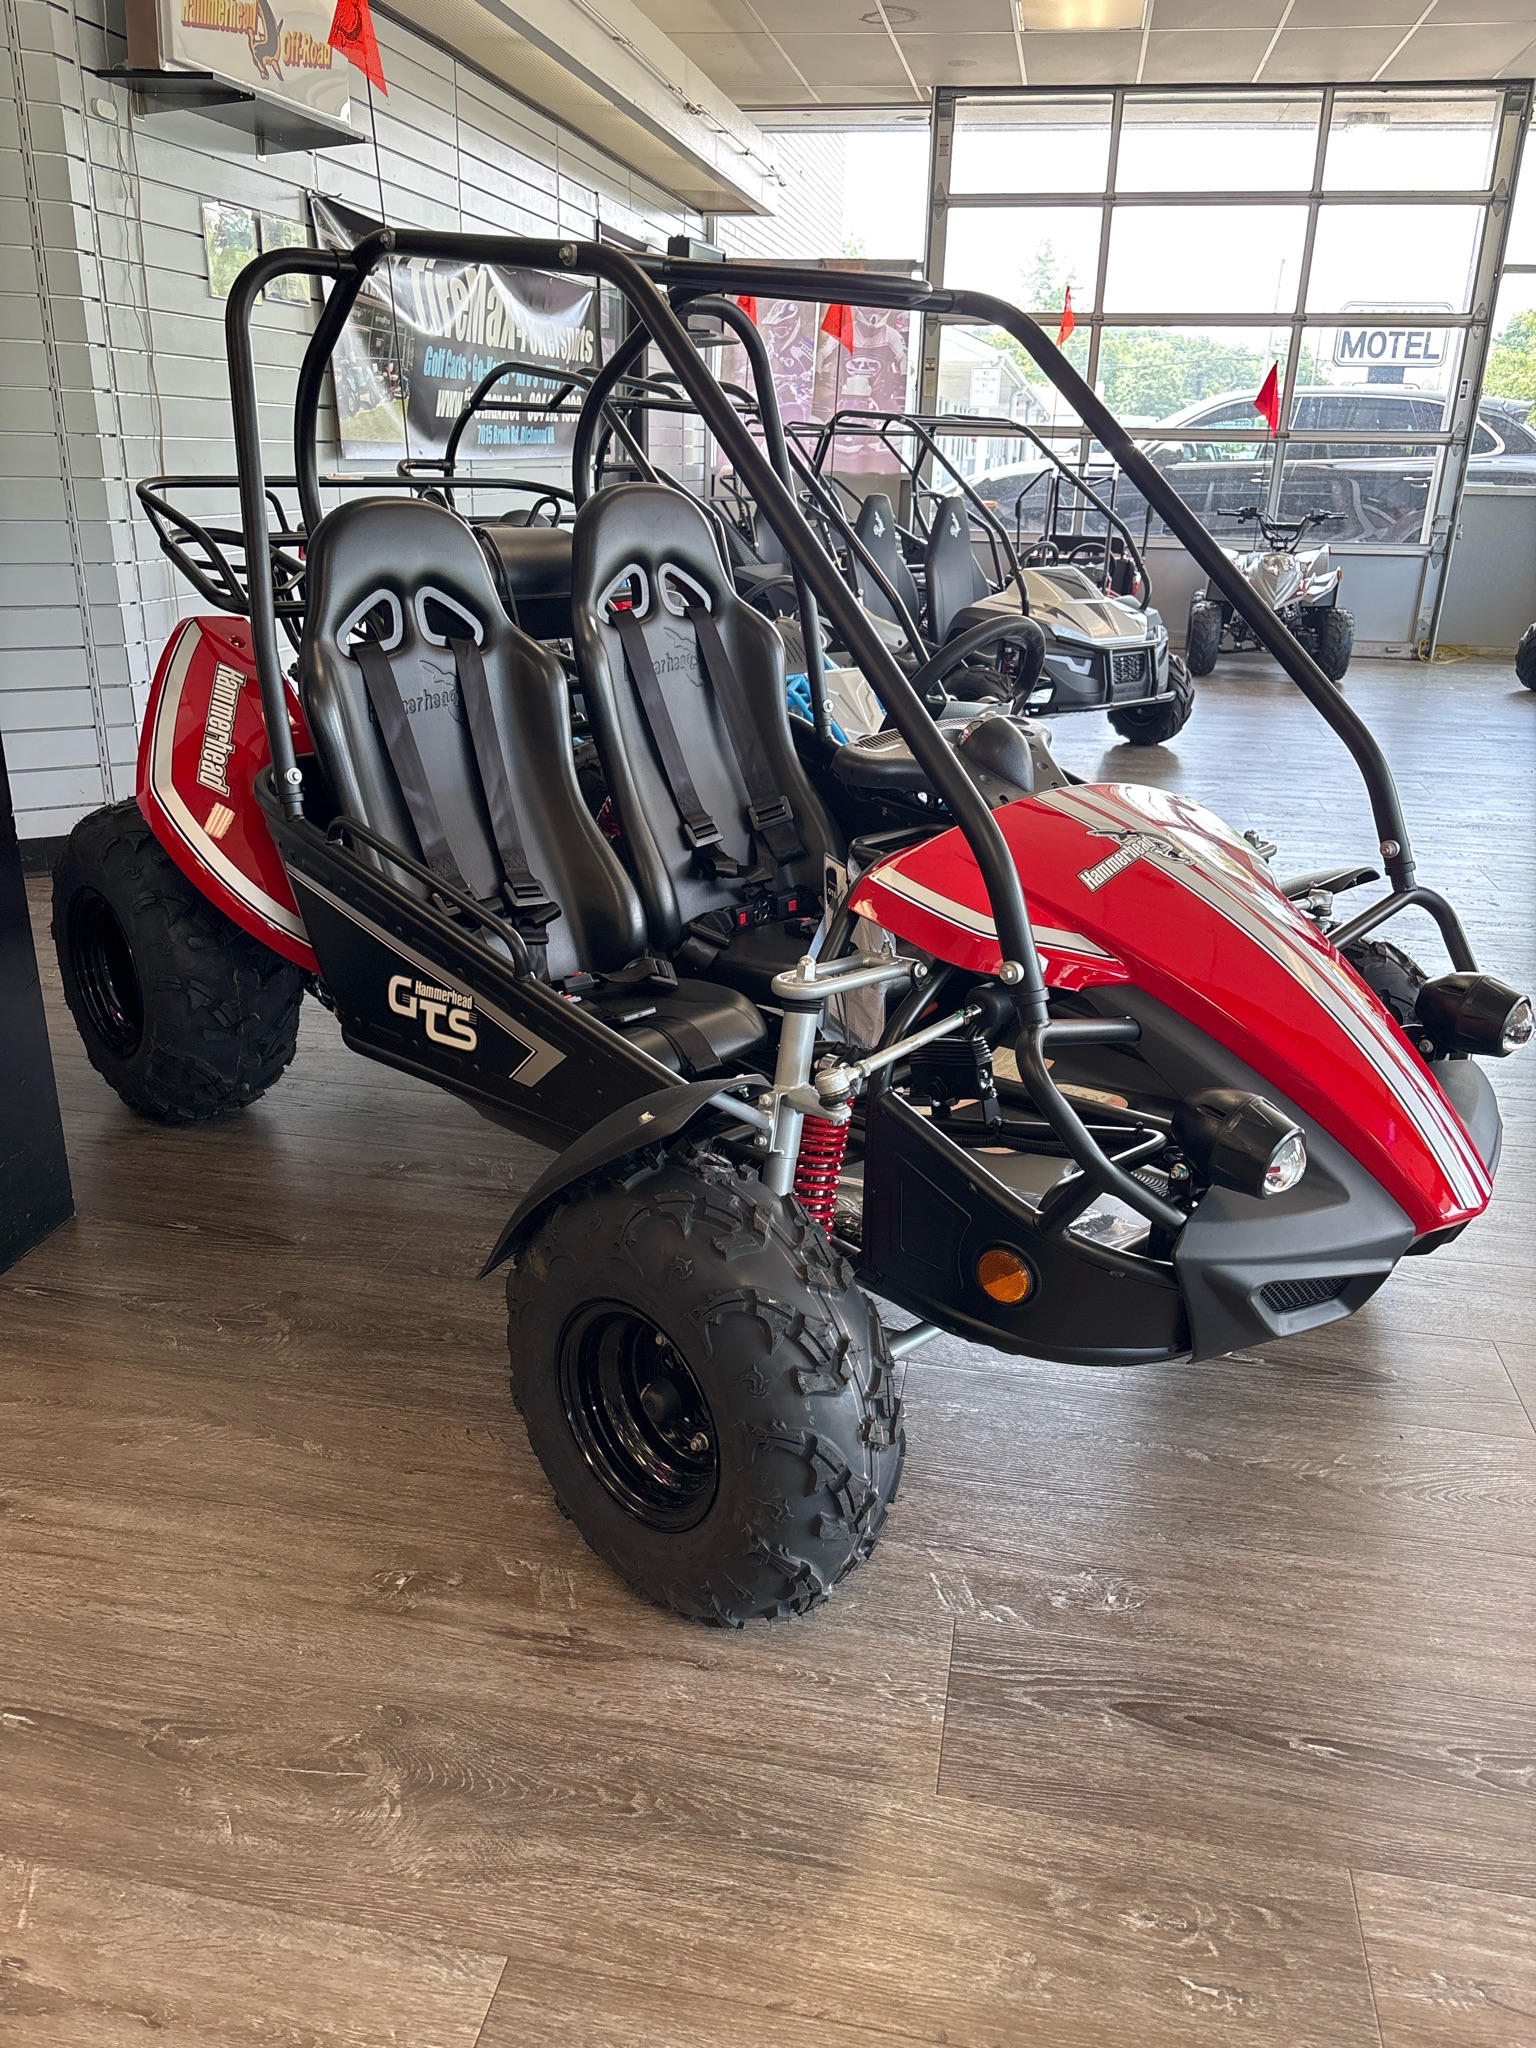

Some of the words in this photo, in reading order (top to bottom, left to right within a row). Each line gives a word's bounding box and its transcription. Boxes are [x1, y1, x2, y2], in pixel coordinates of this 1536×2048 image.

[282, 31, 333, 69] Off-Road
[423, 345, 446, 378] Golf
[444, 348, 467, 381] Carts
[1340, 331, 1440, 359] MOTEL
[478, 424, 493, 444] 7015
[493, 425, 511, 445] Brook
[198, 662, 246, 797] Hammerhead
[1077, 834, 1155, 892] Hammerhead
[388, 974, 478, 1052] GTS
[415, 980, 473, 1010] Hammerhead
